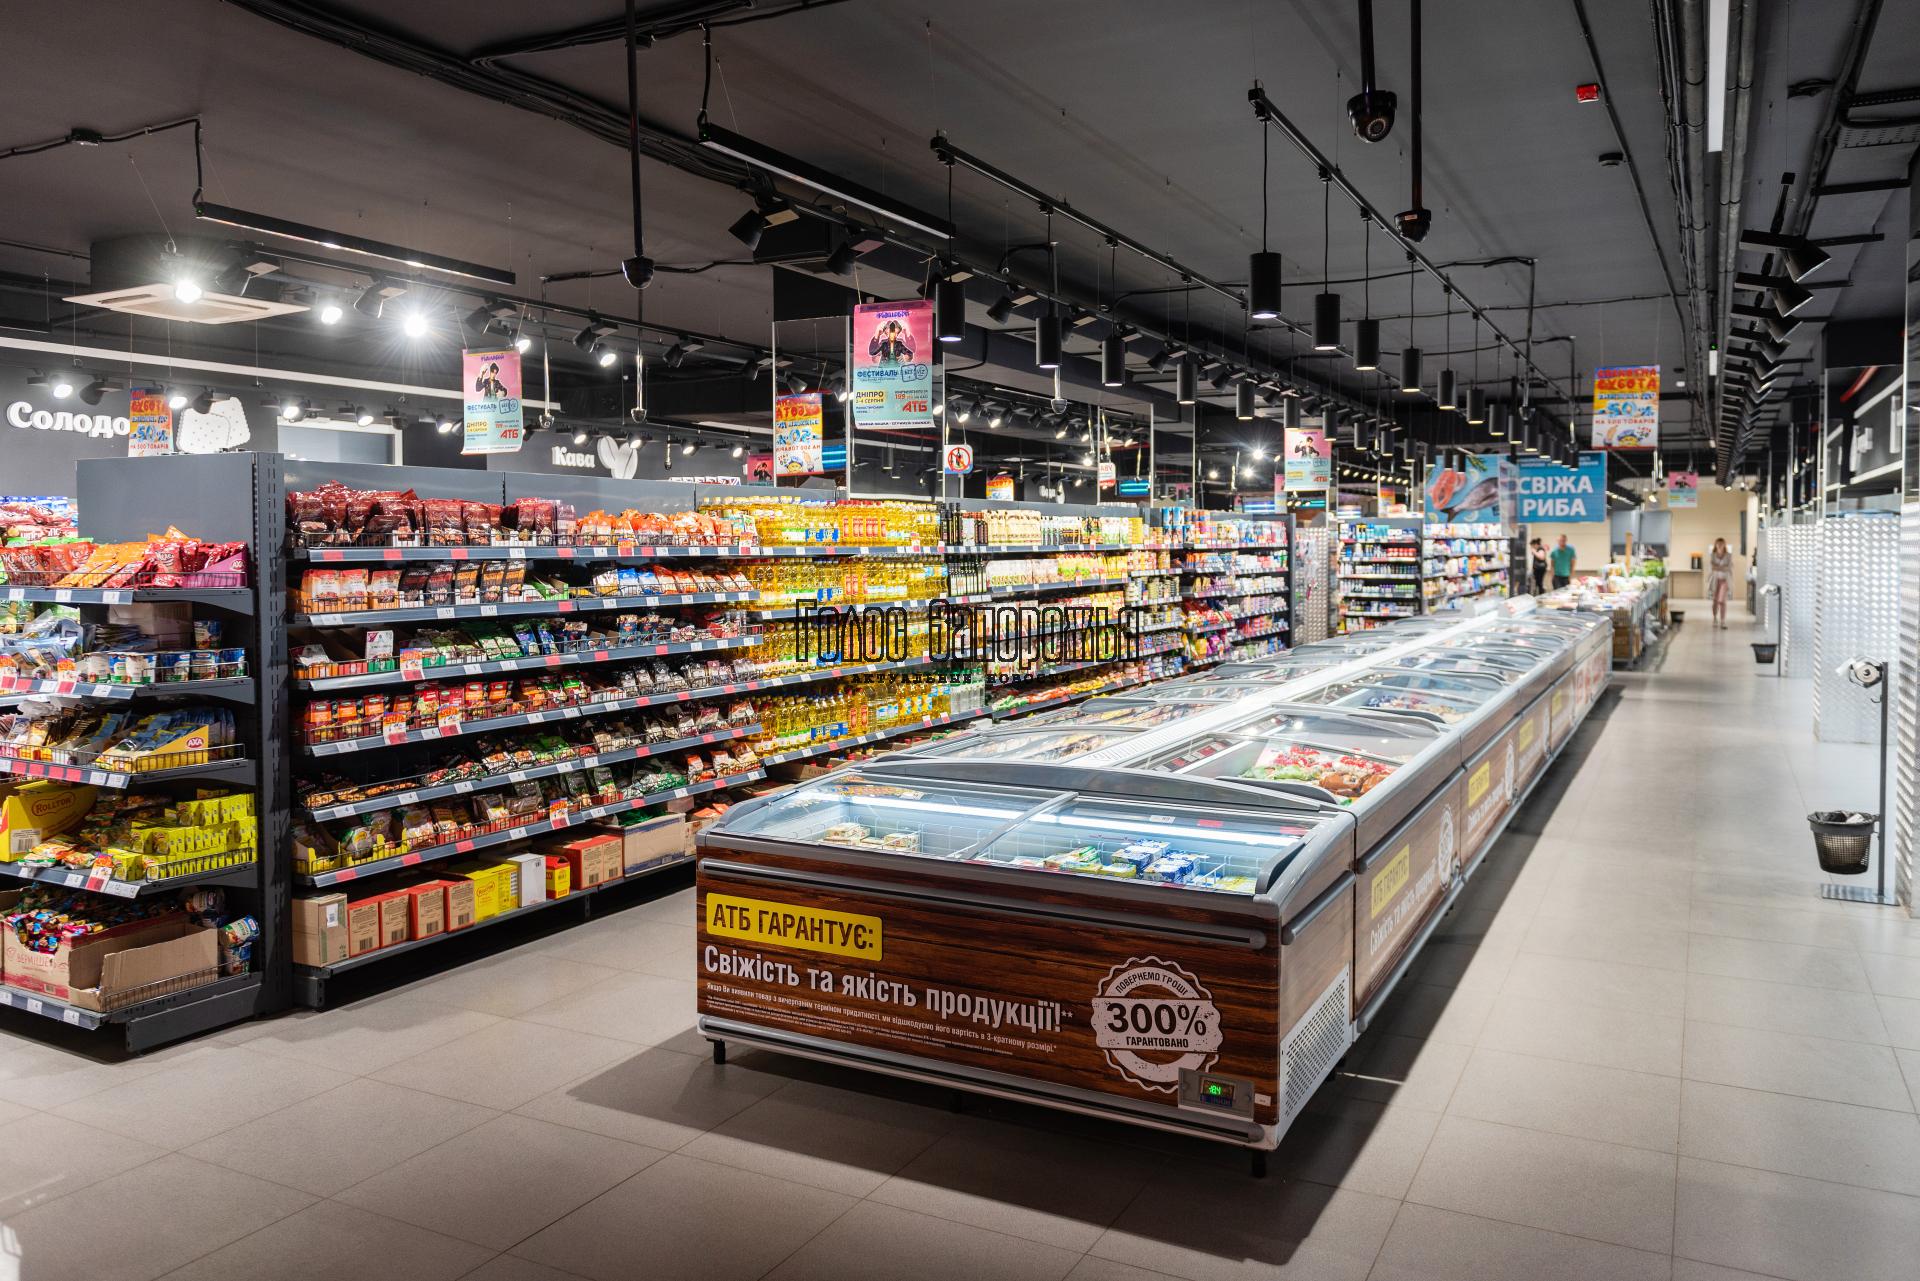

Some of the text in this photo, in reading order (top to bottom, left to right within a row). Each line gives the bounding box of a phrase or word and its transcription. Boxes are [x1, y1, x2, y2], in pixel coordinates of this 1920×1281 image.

[857, 370, 897, 378] ФЕСТИВАЛЬ
[1598, 378, 1656, 390] СУБОТА
[902, 400, 928, 412] АТБ
[7, 401, 130, 438] Солодо
[500, 429, 519, 438] АТБ
[552, 446, 595, 468] Кава
[1520, 475, 1593, 494] СВІЖА
[1523, 498, 1586, 516] РИБА
[188, 739, 202, 747] AXA
[713, 904, 873, 949] АТБ ГАРАНТУЄ:
[704, 945, 800, 986] Свіжість
[807, 968, 833, 992] та
[842, 972, 917, 1007] якість
[1115, 972, 1188, 995] ПОВЕРНЕМО ГРОШІ
[707, 982, 722, 992] Якщо
[756, 993, 772, 1001] товар
[814, 1003, 842, 1014] терміном
[892, 1017, 933, 1030] відшкодуємо
[935, 1024, 950, 1034] його
[952, 1028, 979, 1039] вартість
[987, 1033, 1025, 1049] 3-кратному
[1107, 1003, 1206, 1036] 300%
[1126, 1037, 1188, 1048] ГАРАНТОВАНО
